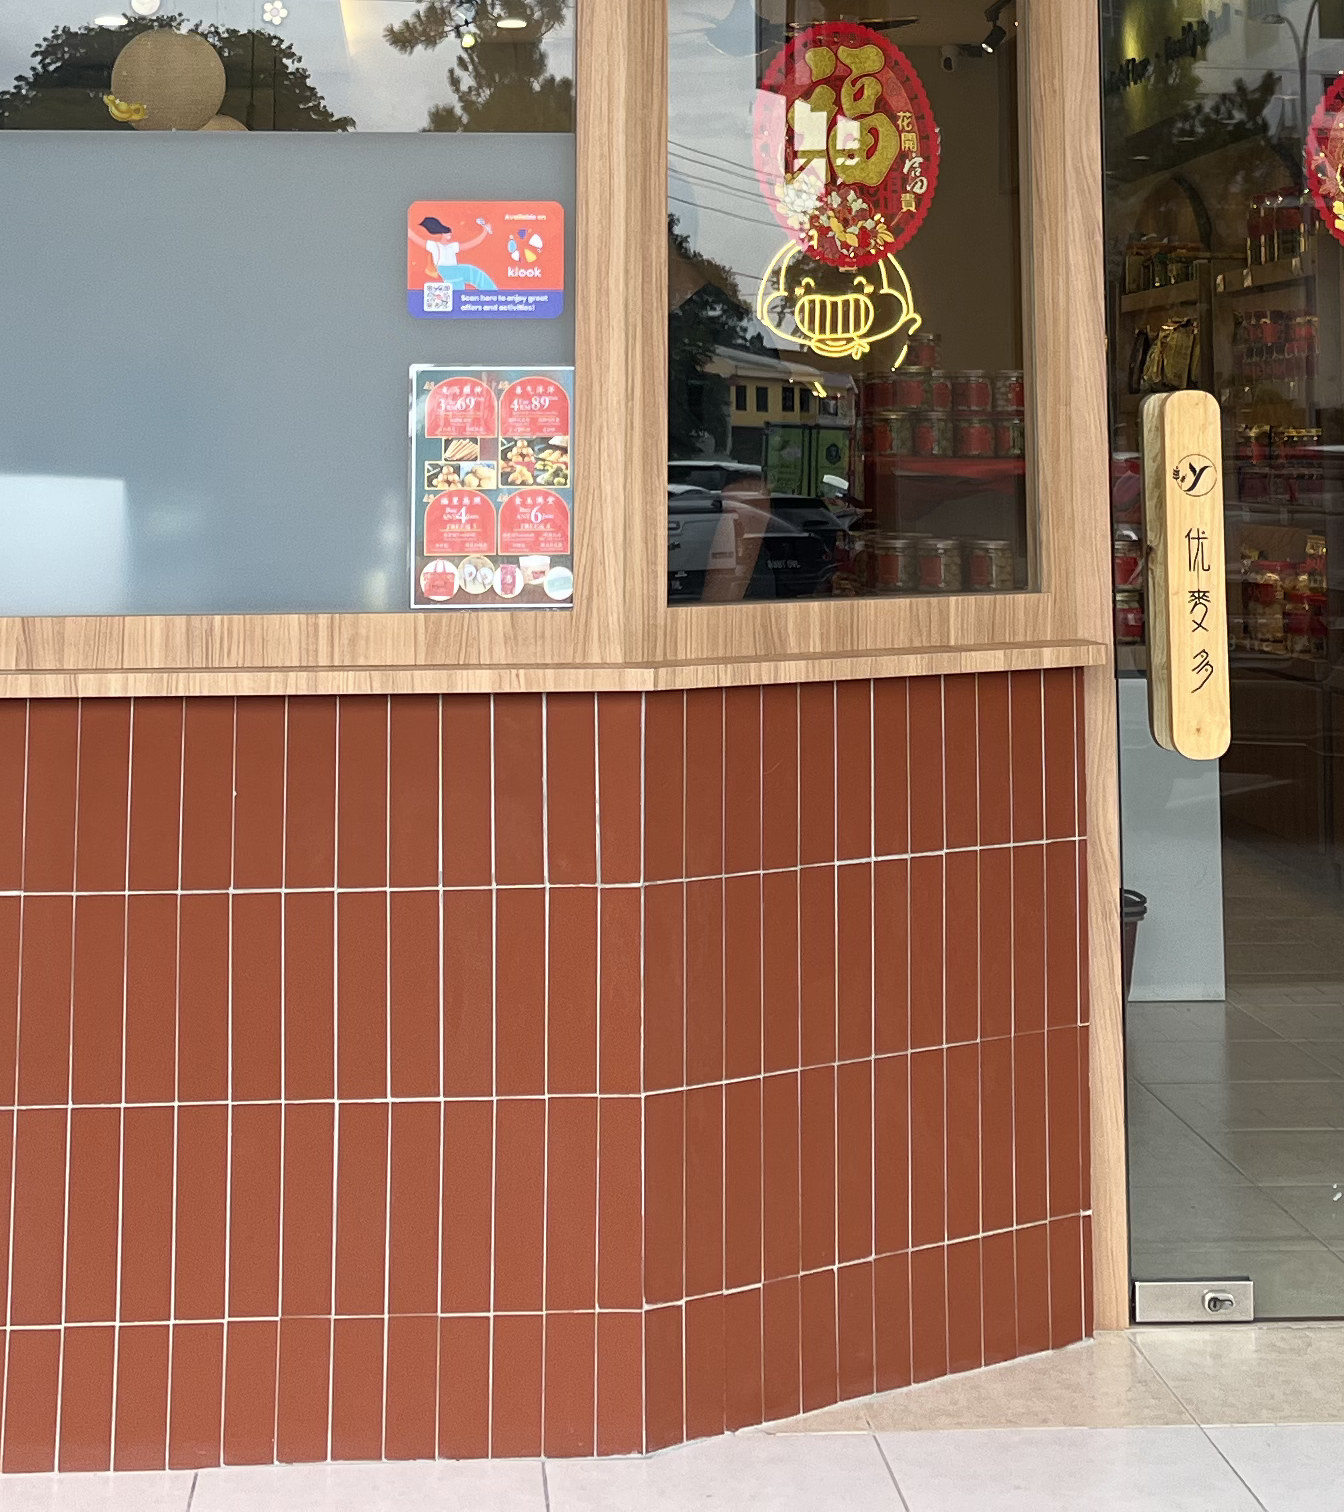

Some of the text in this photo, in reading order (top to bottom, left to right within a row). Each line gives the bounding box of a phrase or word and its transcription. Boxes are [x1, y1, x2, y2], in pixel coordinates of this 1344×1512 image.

[788, 45, 899, 186] 福
[507, 266, 542, 278] klook
[455, 396, 476, 411] 69
[531, 396, 550, 411] 89
[456, 506, 467, 524] 4
[530, 505, 543, 524] 6
